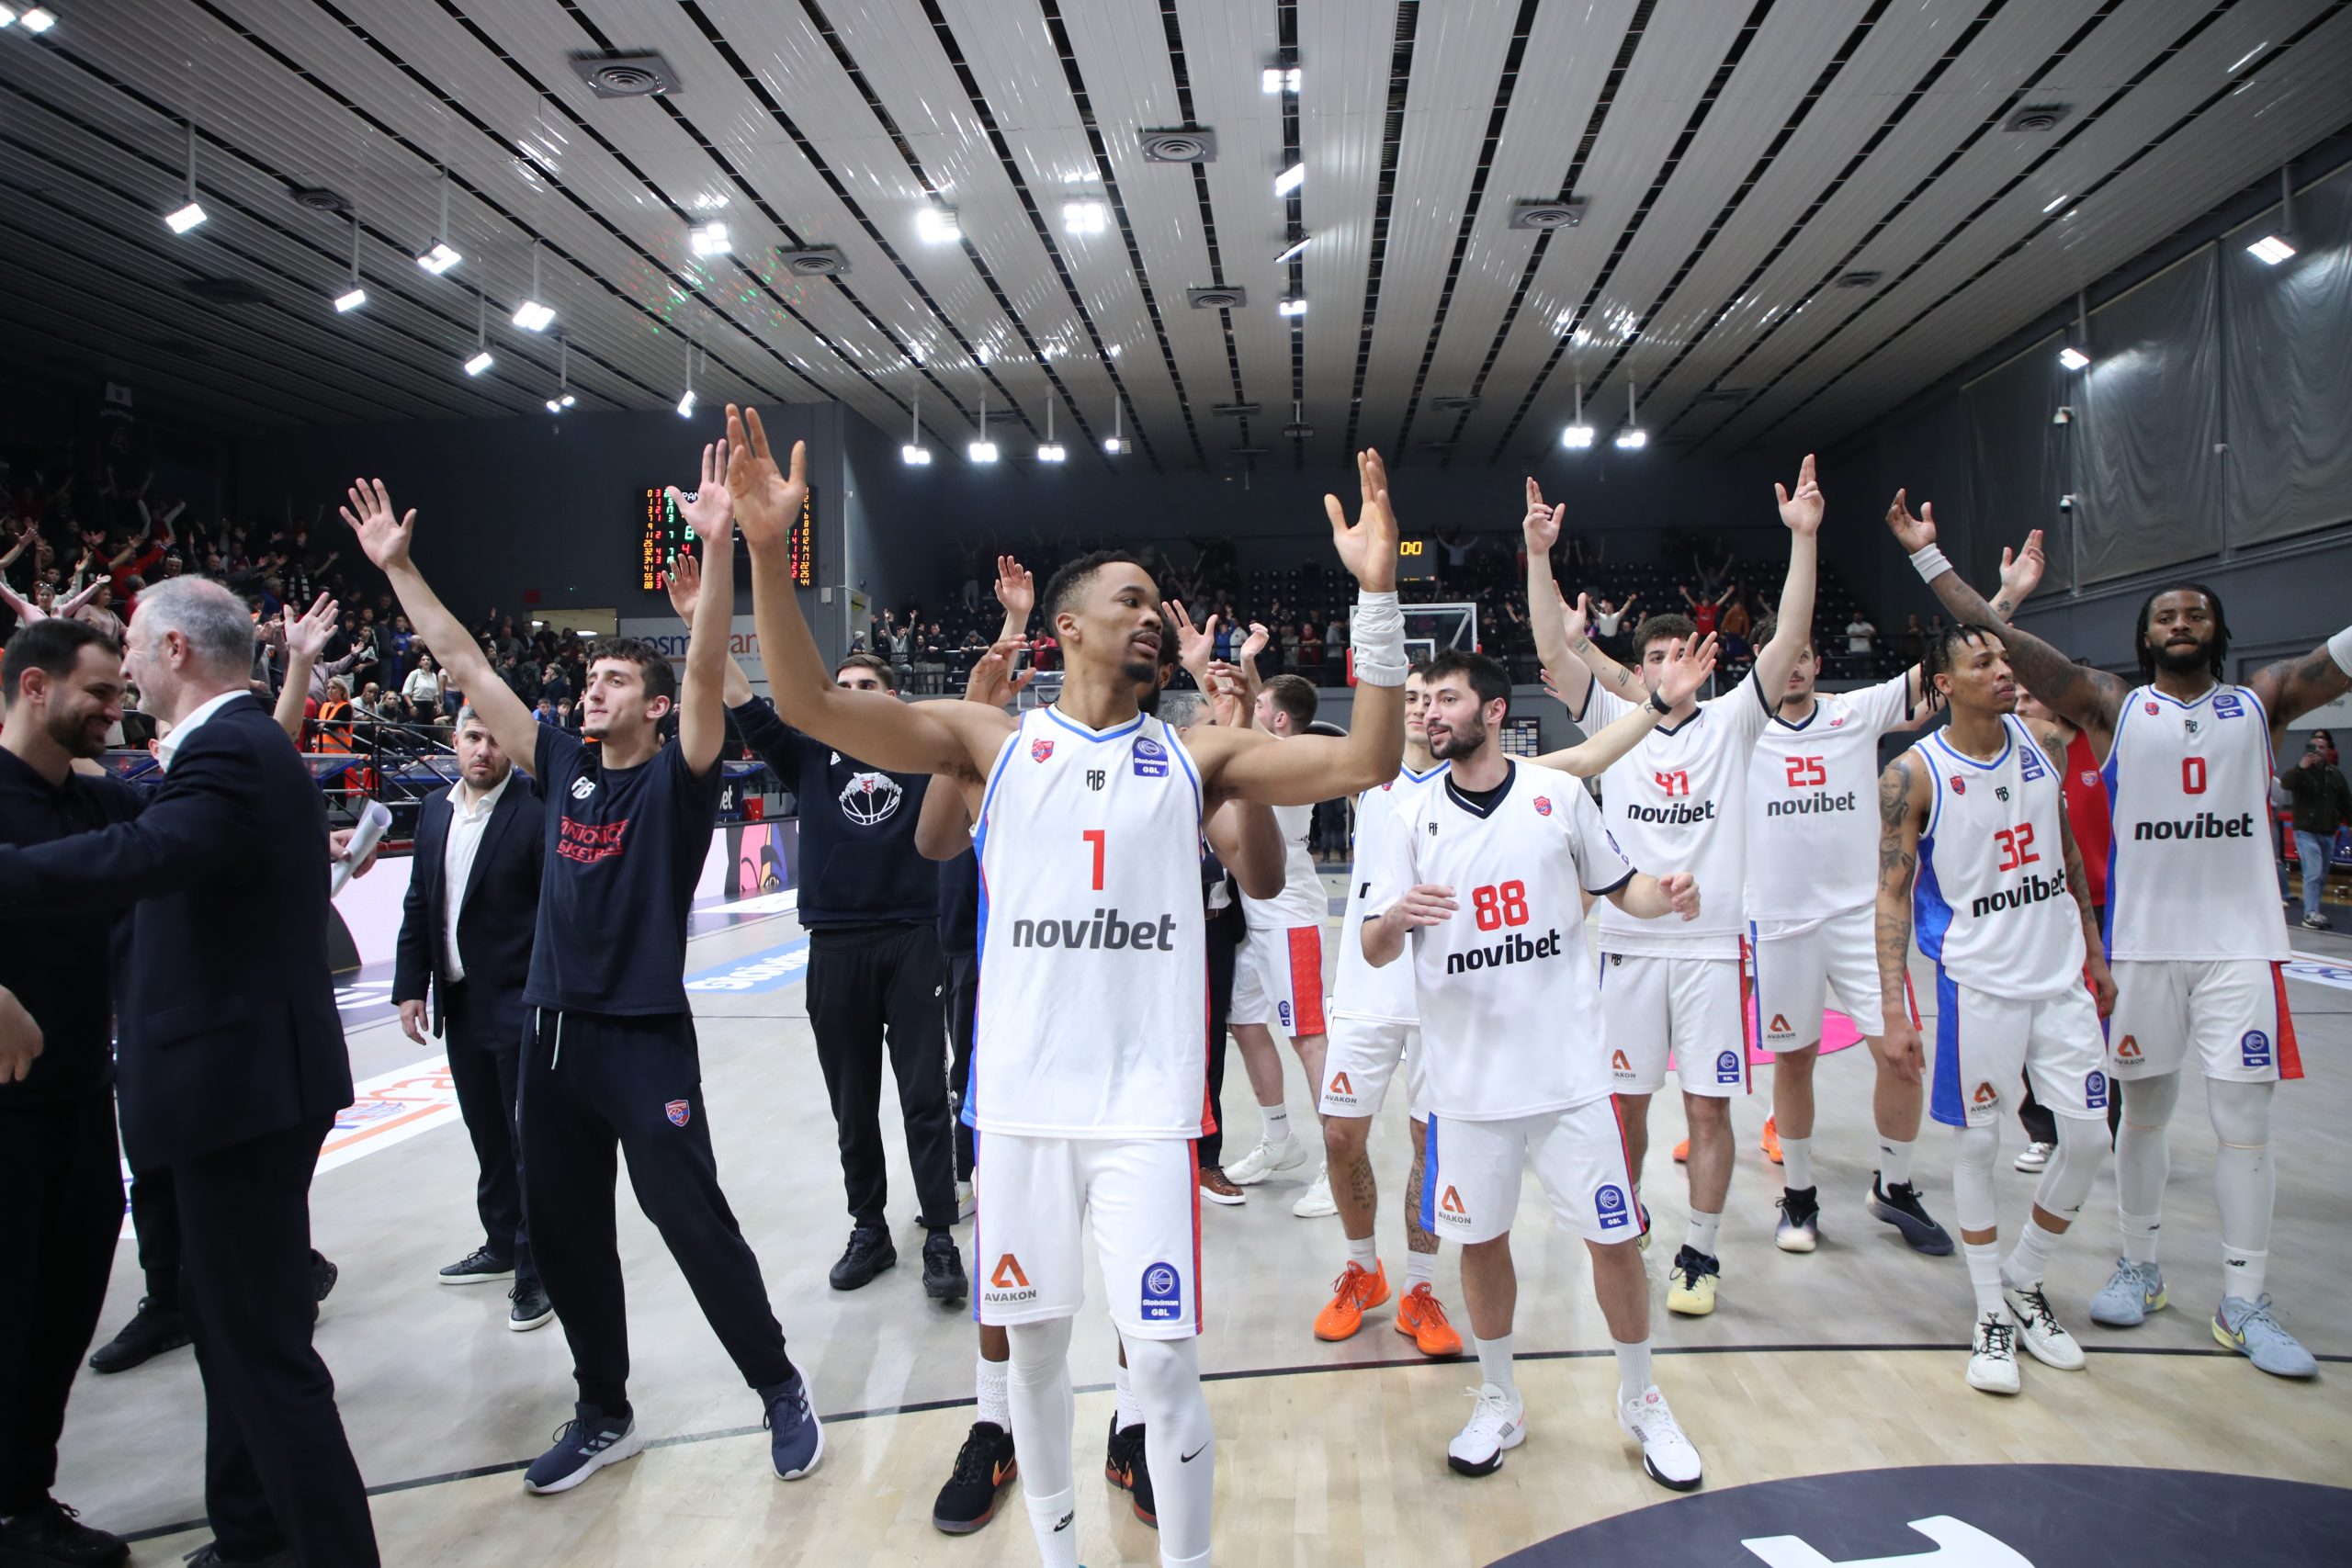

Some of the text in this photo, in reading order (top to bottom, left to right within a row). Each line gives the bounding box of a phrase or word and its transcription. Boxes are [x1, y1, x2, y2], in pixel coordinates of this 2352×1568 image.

[682, 544, 691, 555] 4
[1785, 756, 1826, 787] 25
[2182, 757, 2206, 795] 0
[1627, 800, 1715, 824] novibet
[1767, 791, 1856, 817] novibet
[2134, 812, 2254, 840] novibet
[1083, 829, 1105, 890] 1
[1994, 822, 2041, 872] 32
[1472, 879, 1529, 931] 88
[1973, 868, 2065, 918] novibet
[1012, 908, 1176, 952] novibet
[1447, 929, 1561, 974] novibet
[1325, 1094, 1357, 1104] AVAKON
[984, 1290, 1037, 1303] AVAKON
[1150, 1308, 1170, 1316] GBL
